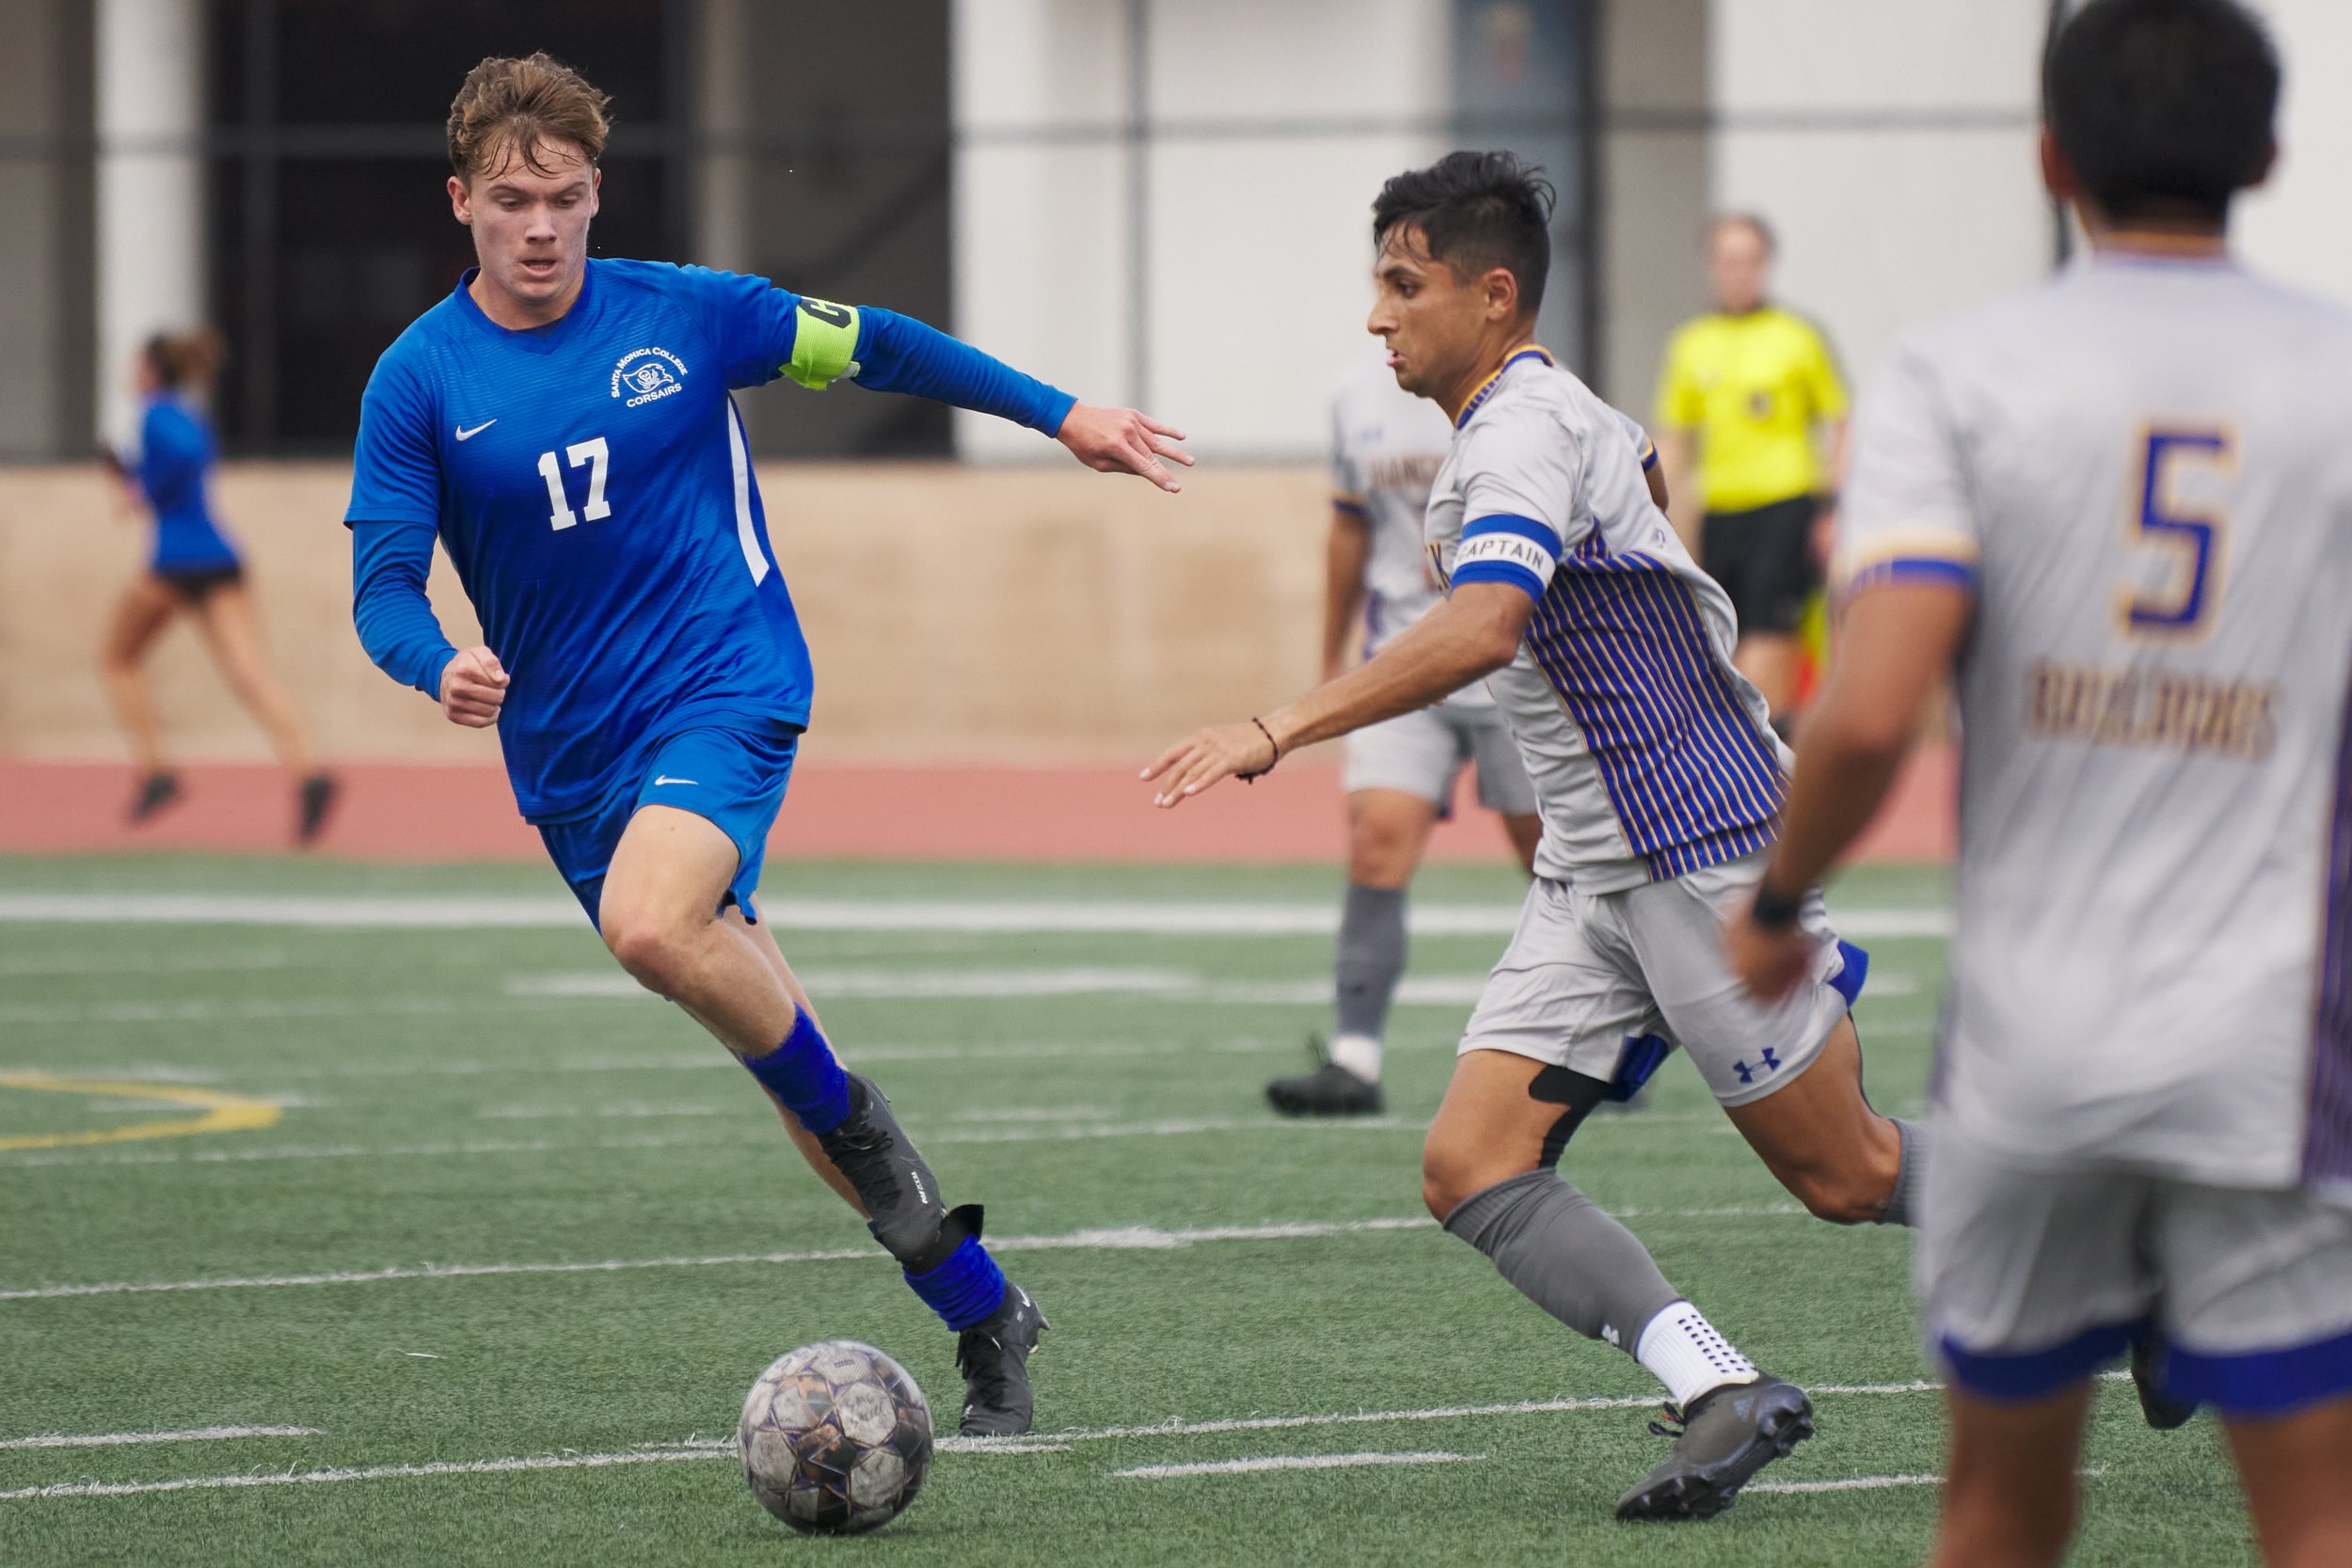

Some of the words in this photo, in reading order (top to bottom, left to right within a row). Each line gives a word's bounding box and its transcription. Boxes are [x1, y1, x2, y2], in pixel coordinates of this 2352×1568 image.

[616, 347, 652, 370] MONICA
[652, 346, 689, 376] COLLEGE
[611, 369, 623, 399] SANTA
[626, 383, 683, 408] CORSAIRS
[537, 436, 612, 532] 17
[2115, 423, 2241, 641] 5
[1456, 539, 1545, 572] CAPTAIN
